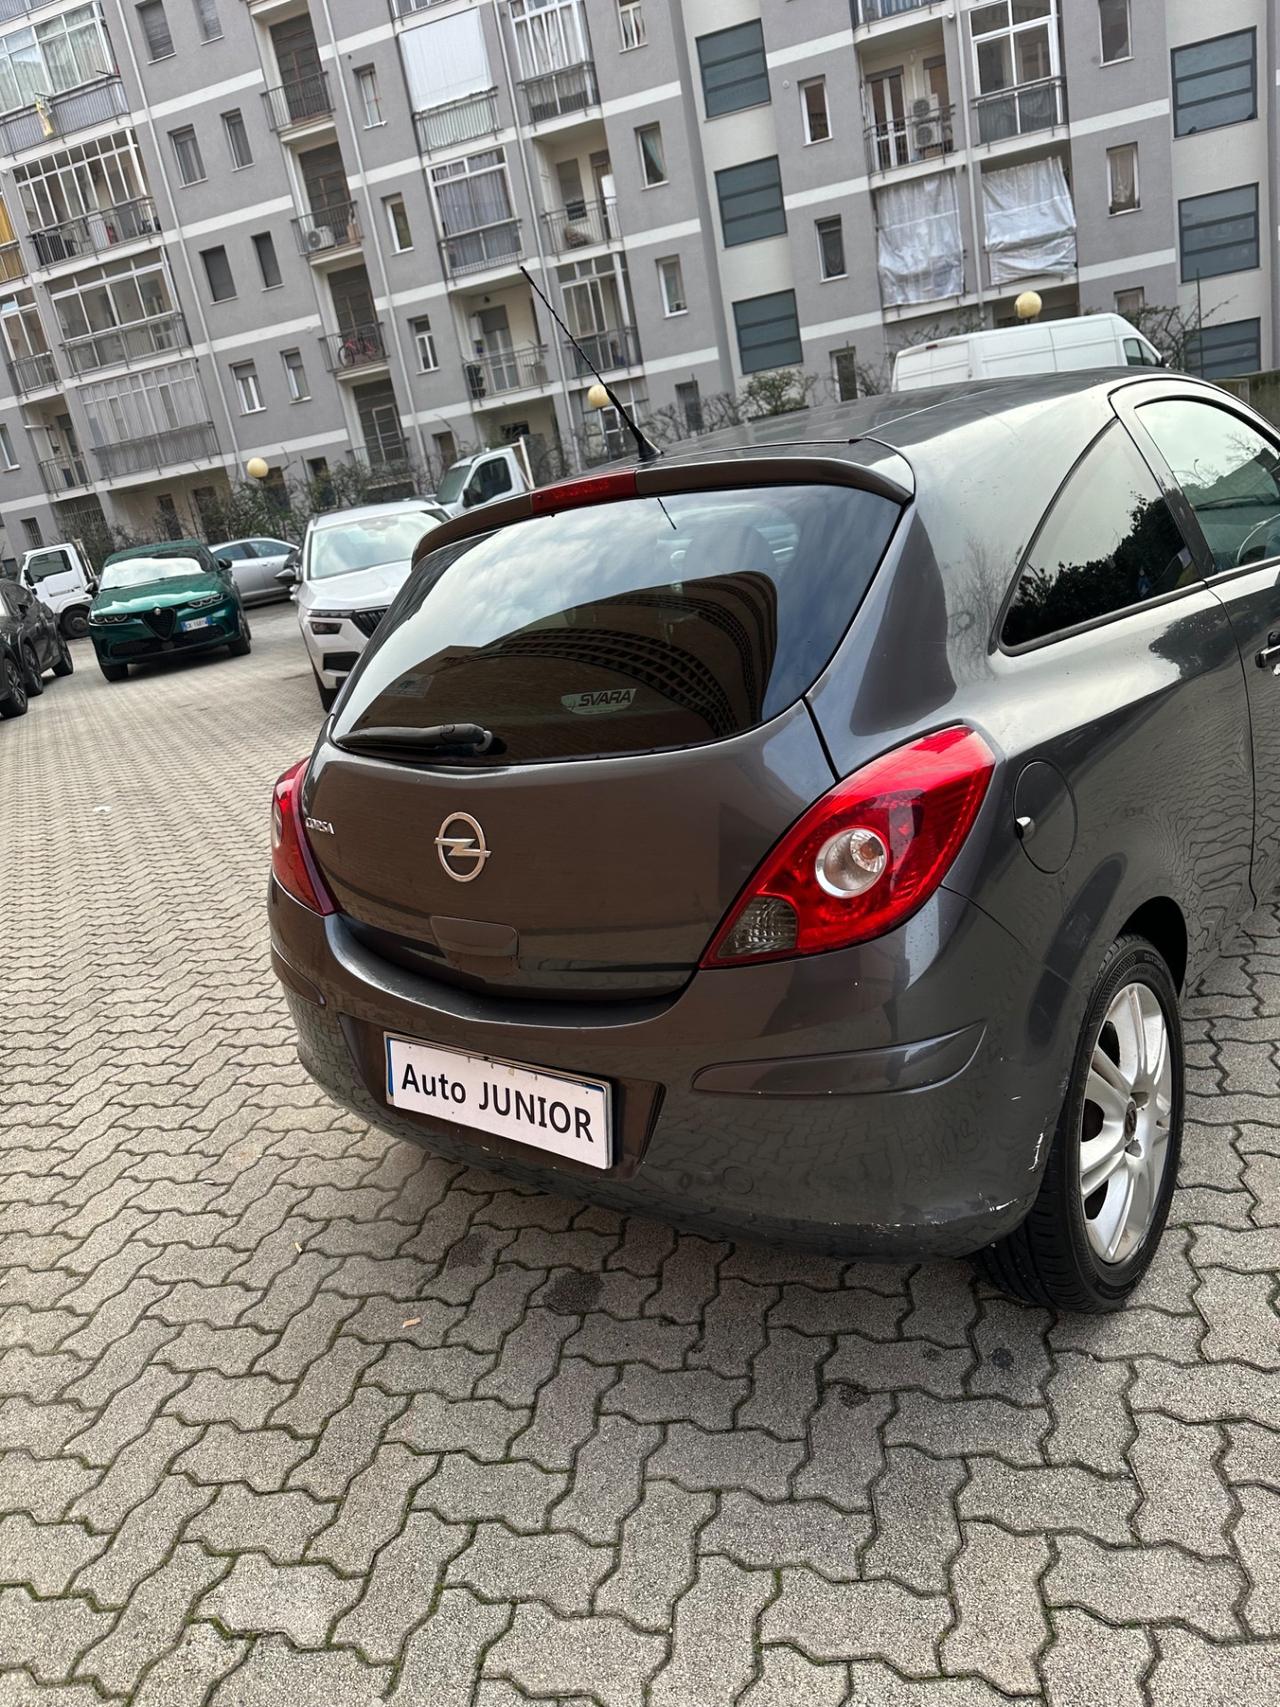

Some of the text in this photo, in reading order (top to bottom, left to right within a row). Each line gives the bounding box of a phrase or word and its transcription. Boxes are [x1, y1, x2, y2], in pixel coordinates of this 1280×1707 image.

[579, 690, 632, 707] SVARA
[305, 817, 335, 835] CORSA
[401, 1063, 595, 1143] Auto JUNIOR
